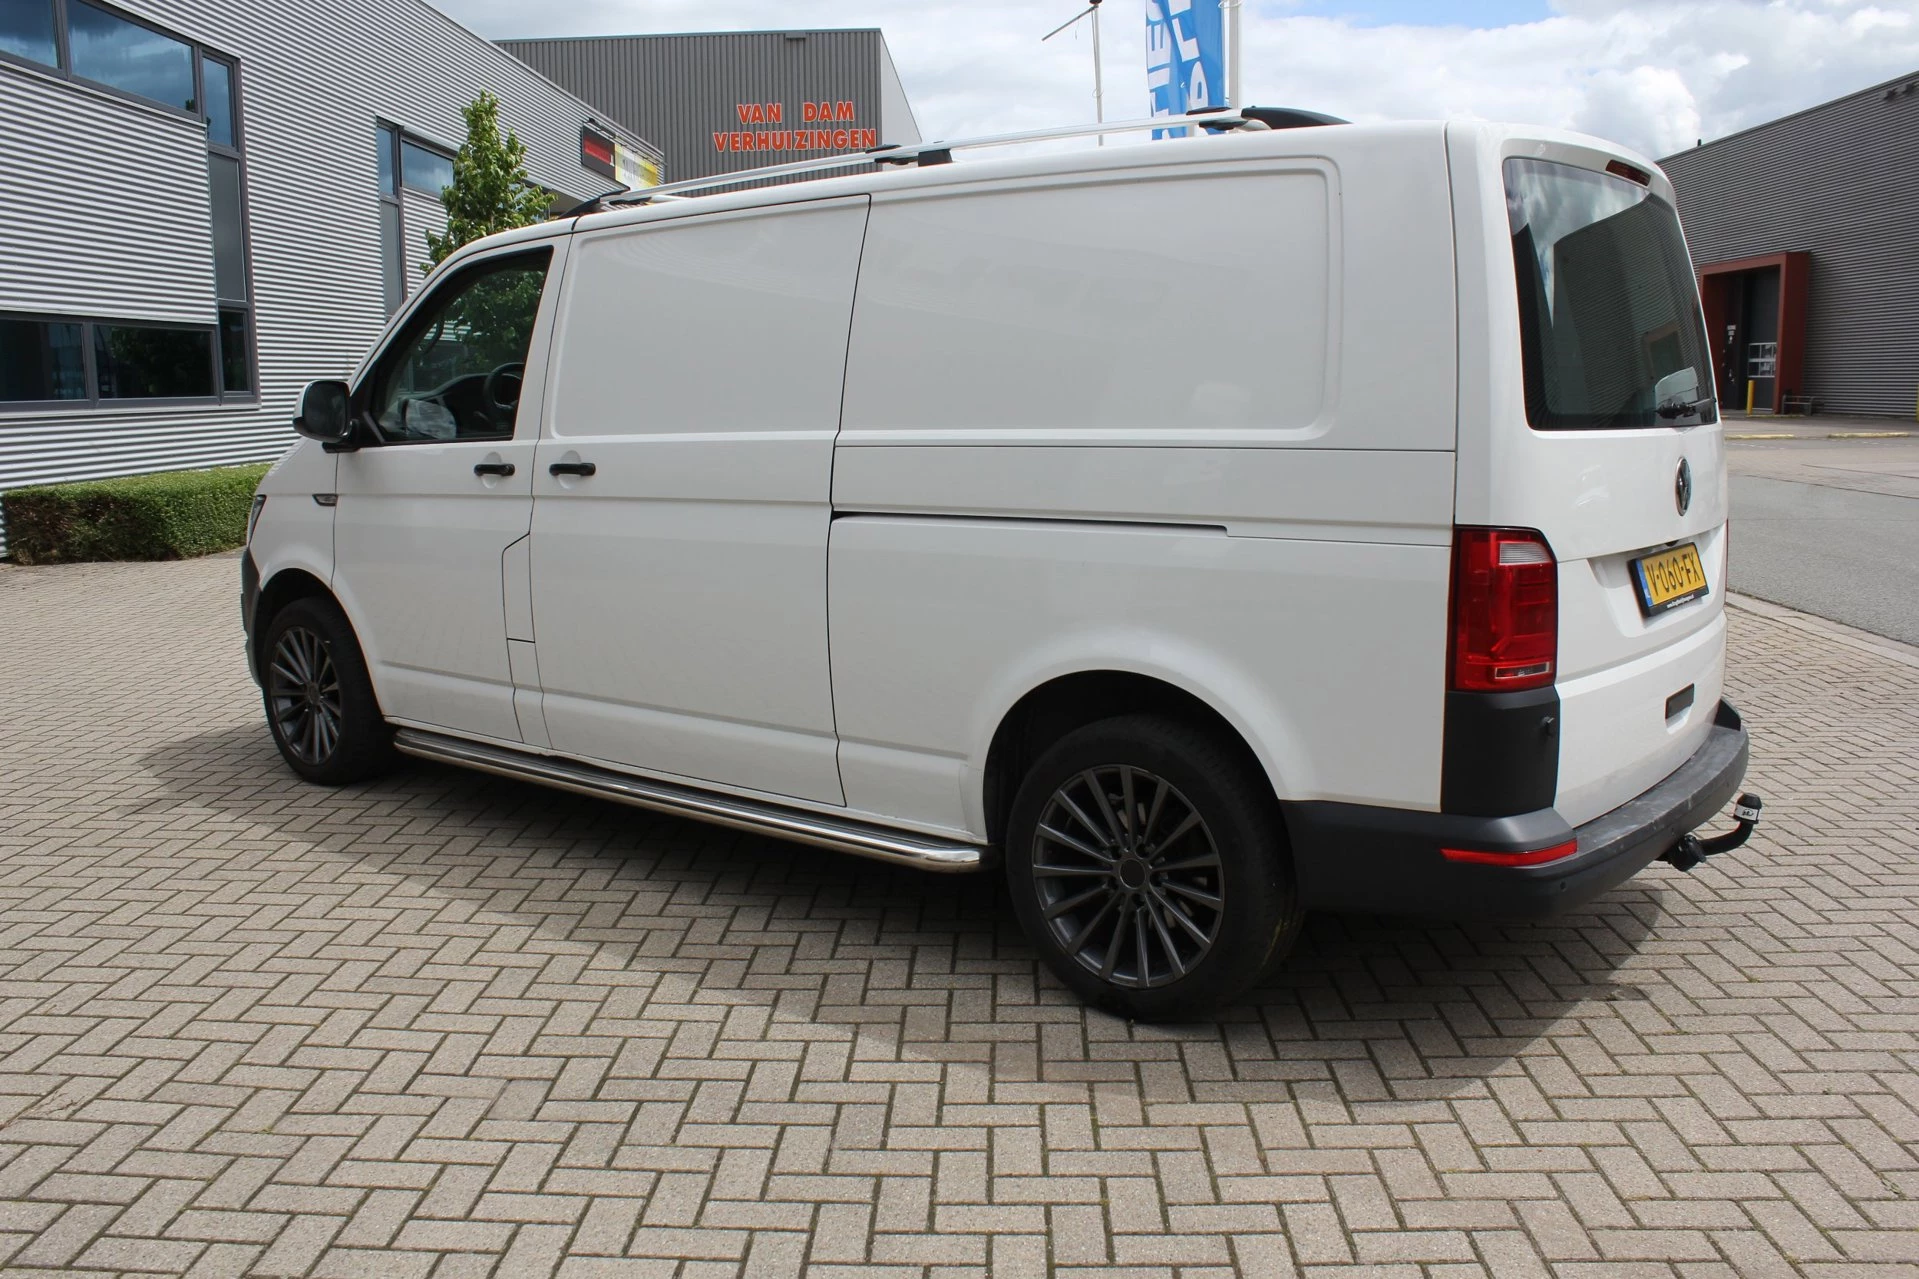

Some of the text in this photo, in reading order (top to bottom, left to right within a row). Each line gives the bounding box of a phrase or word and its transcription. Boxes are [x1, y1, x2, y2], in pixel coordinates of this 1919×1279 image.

[737, 101, 855, 124] VAN DAM
[713, 128, 877, 152] VERHUIZINGEN
